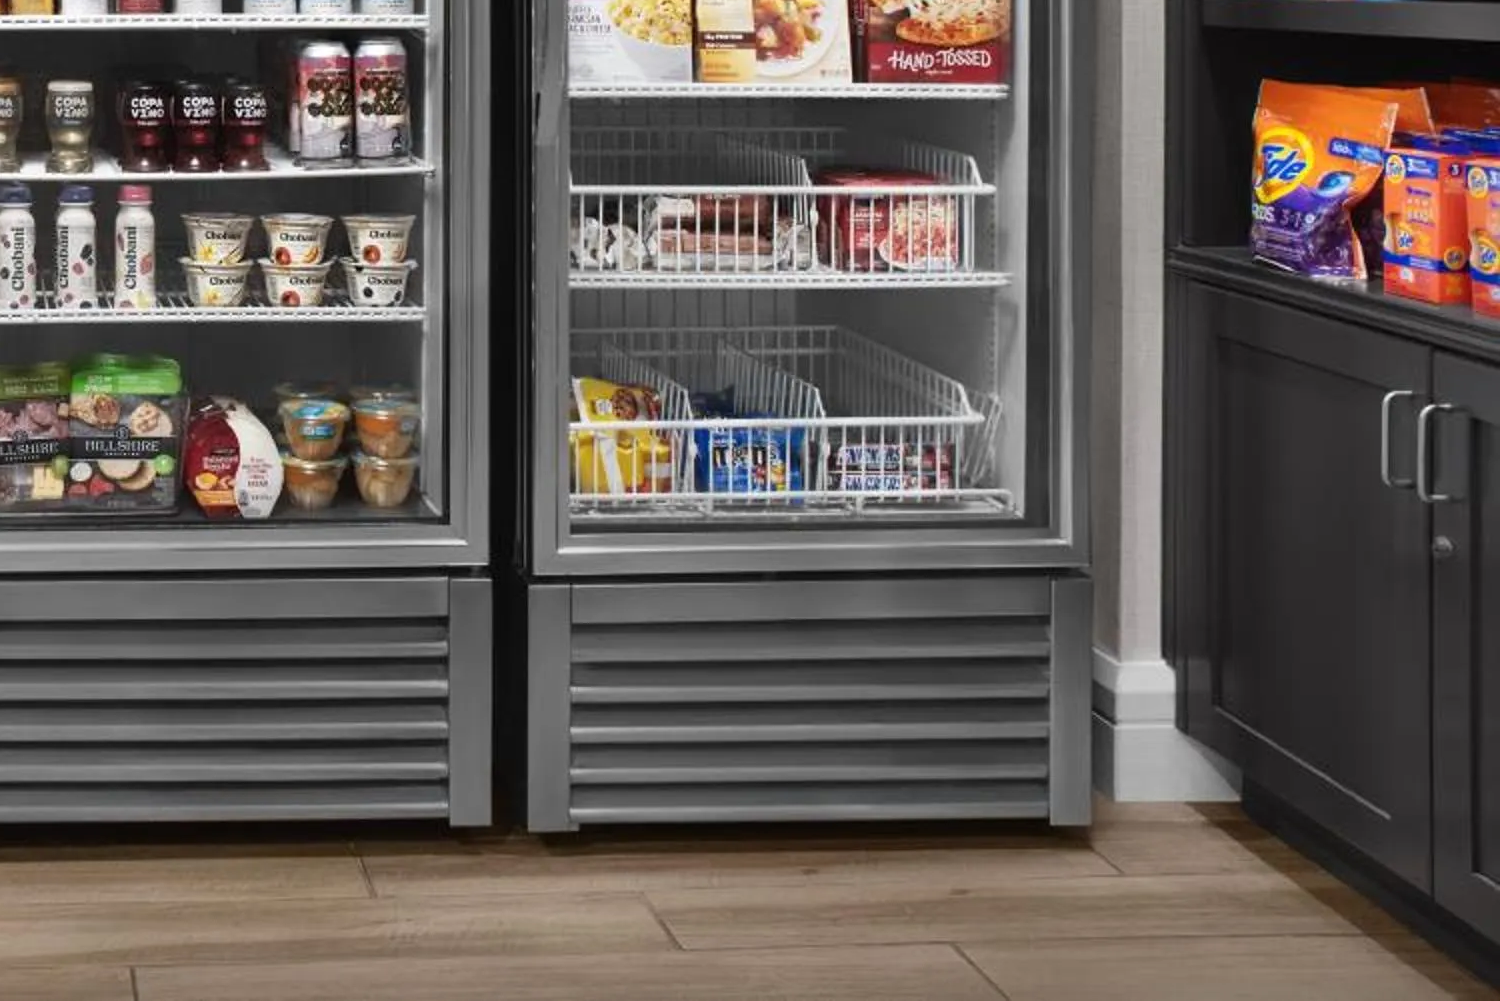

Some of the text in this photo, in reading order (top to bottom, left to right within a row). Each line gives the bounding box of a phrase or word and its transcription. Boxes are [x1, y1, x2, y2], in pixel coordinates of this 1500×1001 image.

[54, 96, 87, 107] COPA
[131, 97, 164, 108] COPA
[55, 107, 90, 118] VINO
[131, 108, 165, 119] VINO
[1261, 143, 1307, 181] Tide
[11, 227, 26, 291] Chobani
[58, 225, 70, 289] Chobani
[124, 226, 138, 290] Chobani
[85, 440, 160, 453] HILLSHIRE
